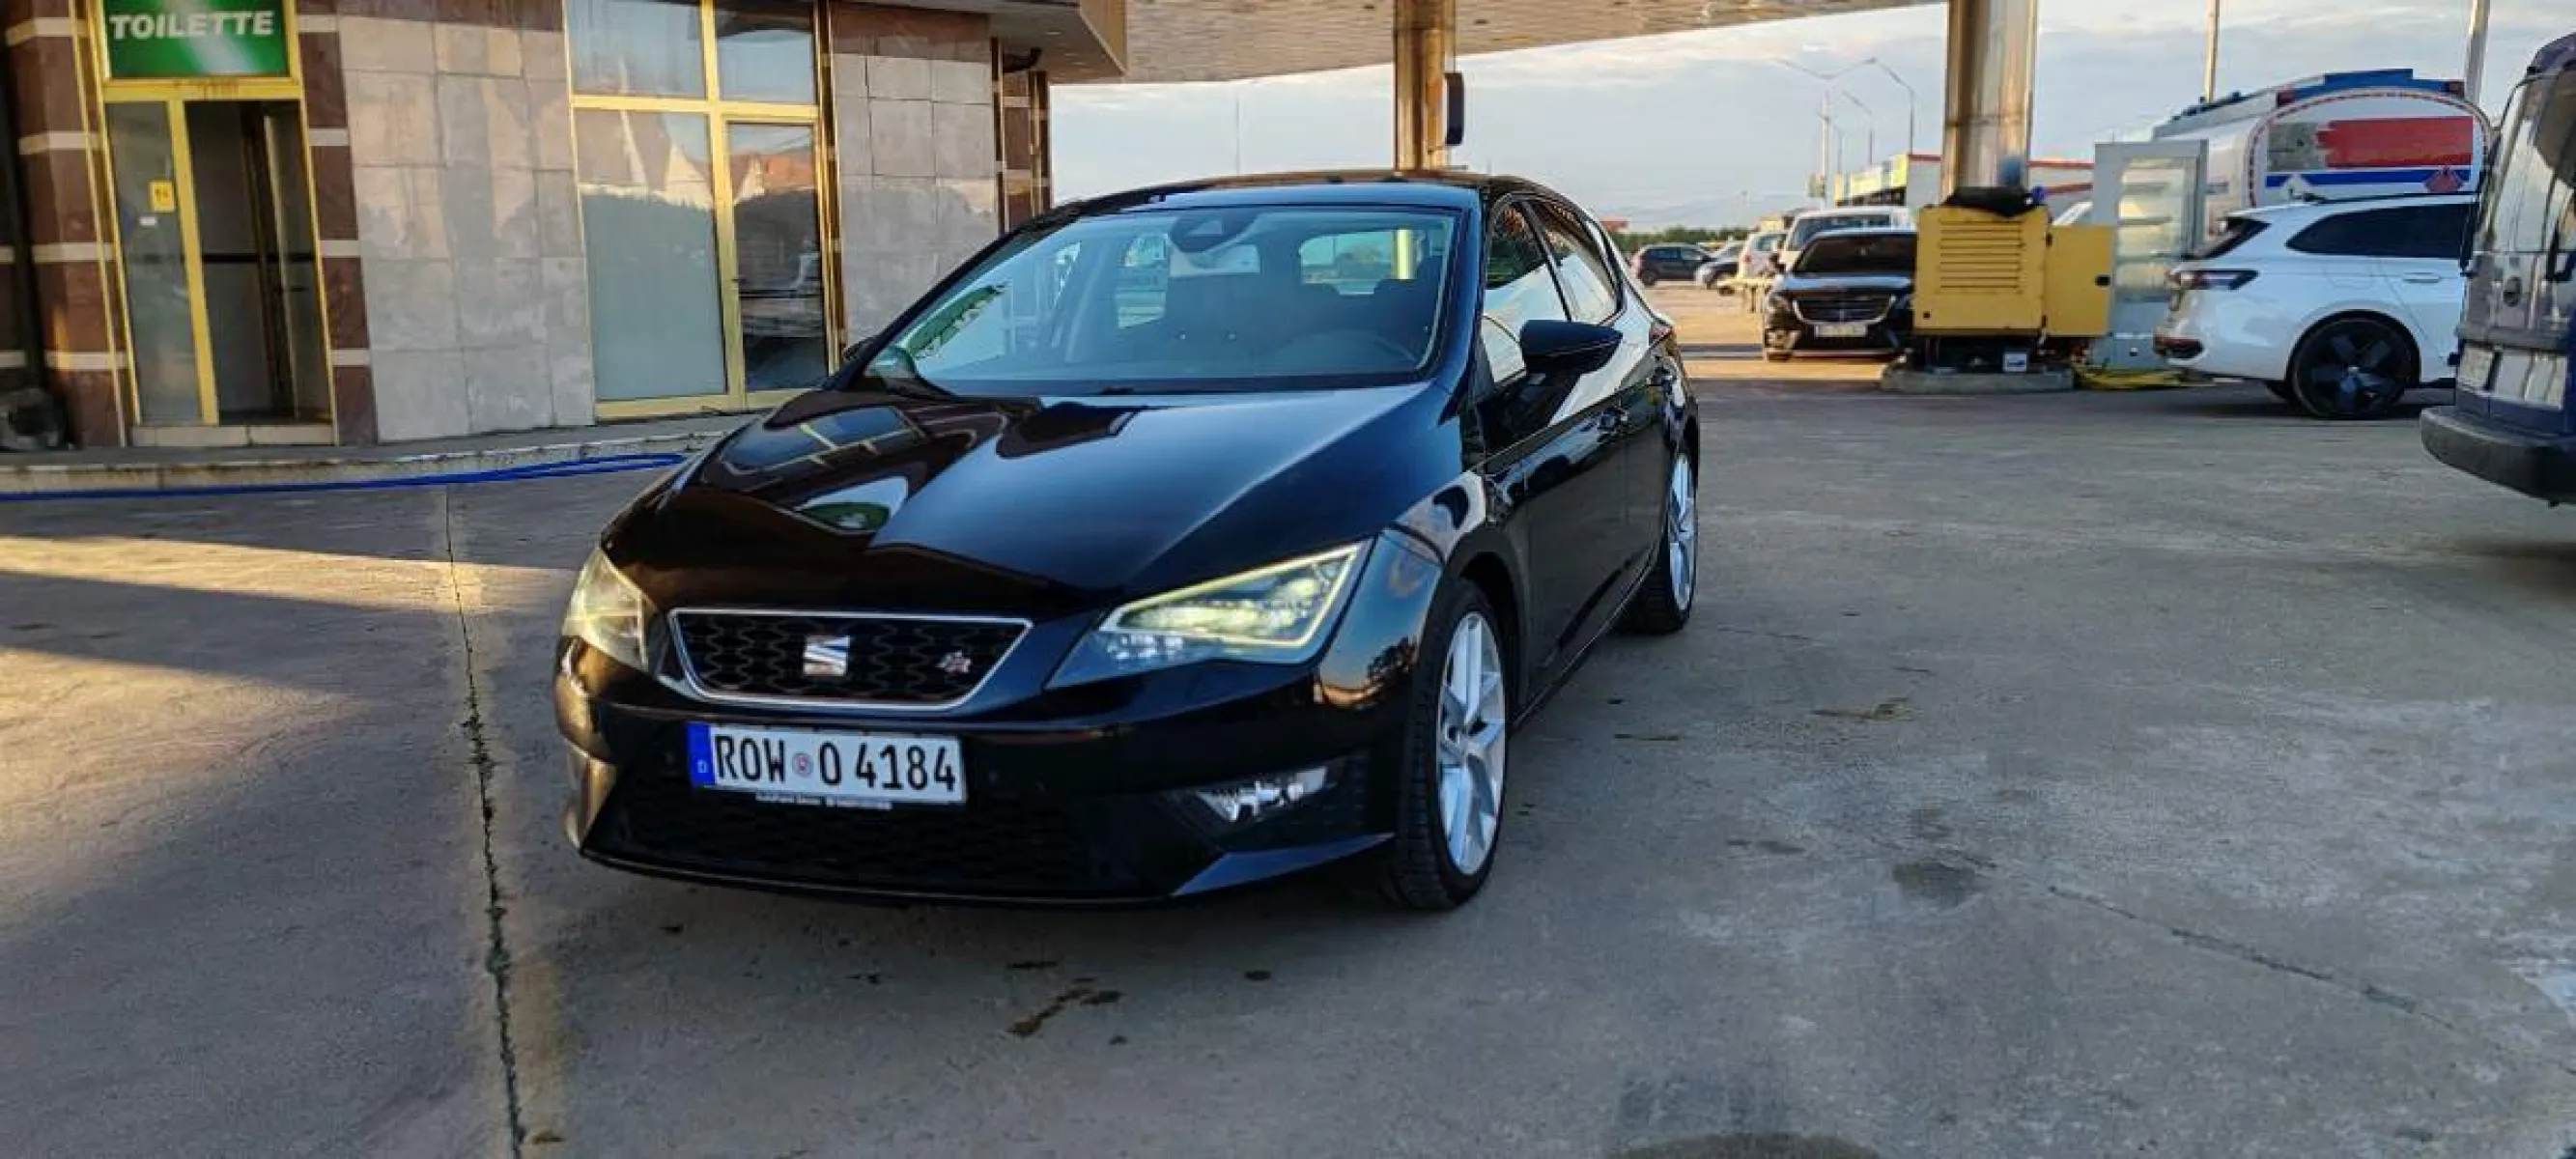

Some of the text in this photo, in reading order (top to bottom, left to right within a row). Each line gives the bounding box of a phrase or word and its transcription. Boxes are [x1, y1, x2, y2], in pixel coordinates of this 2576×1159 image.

[109, 11, 274, 40] TOILETTE
[716, 735, 785, 783] ROW
[856, 742, 956, 792] 4184
